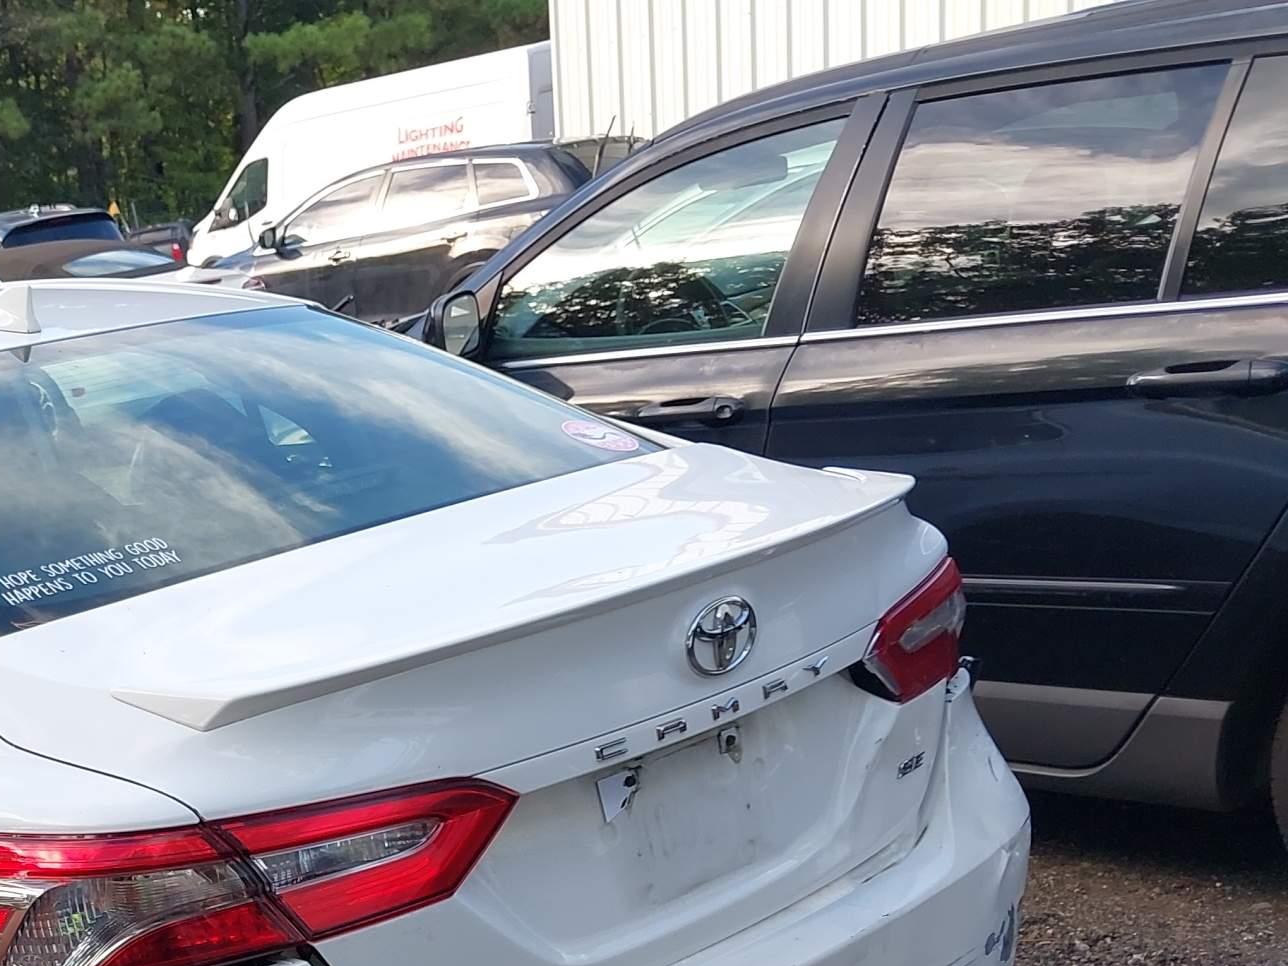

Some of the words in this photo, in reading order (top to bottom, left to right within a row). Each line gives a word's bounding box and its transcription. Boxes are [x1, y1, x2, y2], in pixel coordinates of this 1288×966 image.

[398, 116, 464, 144] LIGHTING
[1, 577, 73, 606] HAPPENS
[72, 571, 98, 586] TO
[98, 560, 134, 578] YOU
[132, 549, 182, 570] TODAY
[40, 548, 124, 578] SOMETHING
[125, 537, 168, 556] GOOD
[595, 655, 829, 761] CAMRY
[896, 751, 926, 779] SE
